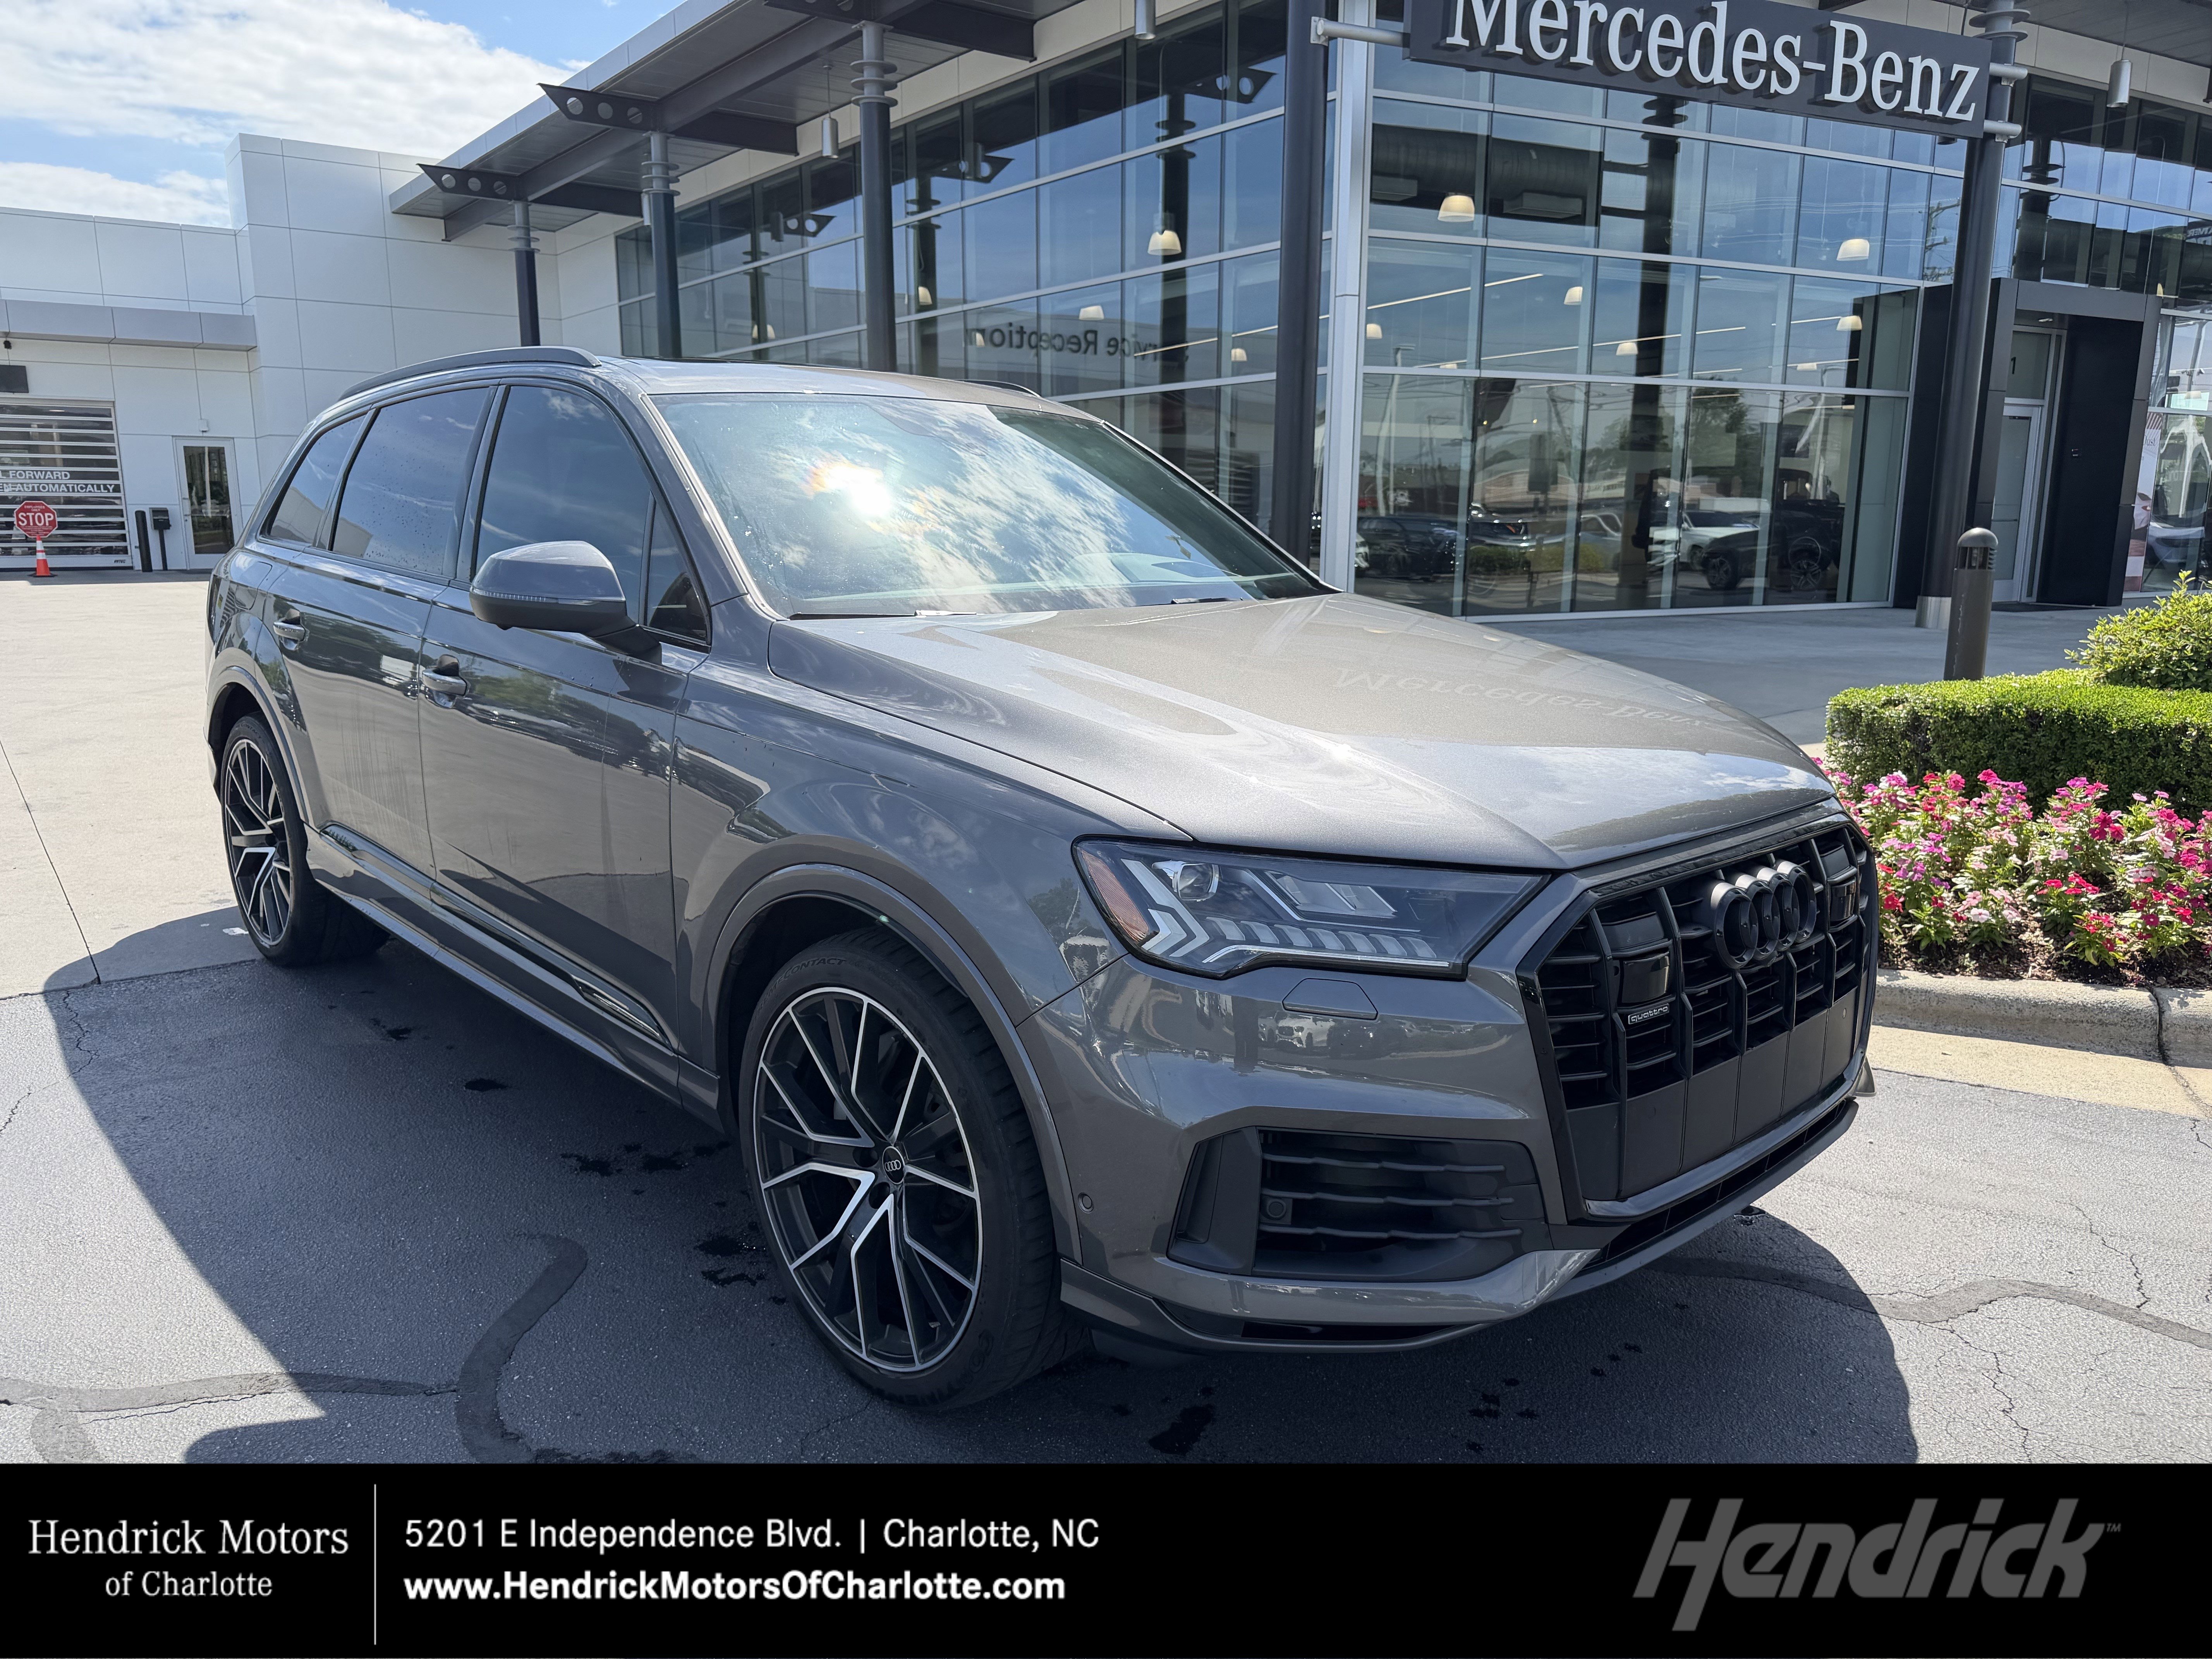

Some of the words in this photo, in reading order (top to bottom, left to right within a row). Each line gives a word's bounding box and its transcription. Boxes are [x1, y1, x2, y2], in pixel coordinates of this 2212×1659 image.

[1446, 0, 1979, 121] Mercedes-Benz
[9, 471, 70, 479] FORWARD
[16, 483, 114, 493] AUTOMATICALLY
[18, 512, 53, 526] STOP
[1631, 1006, 1668, 1022] quattro
